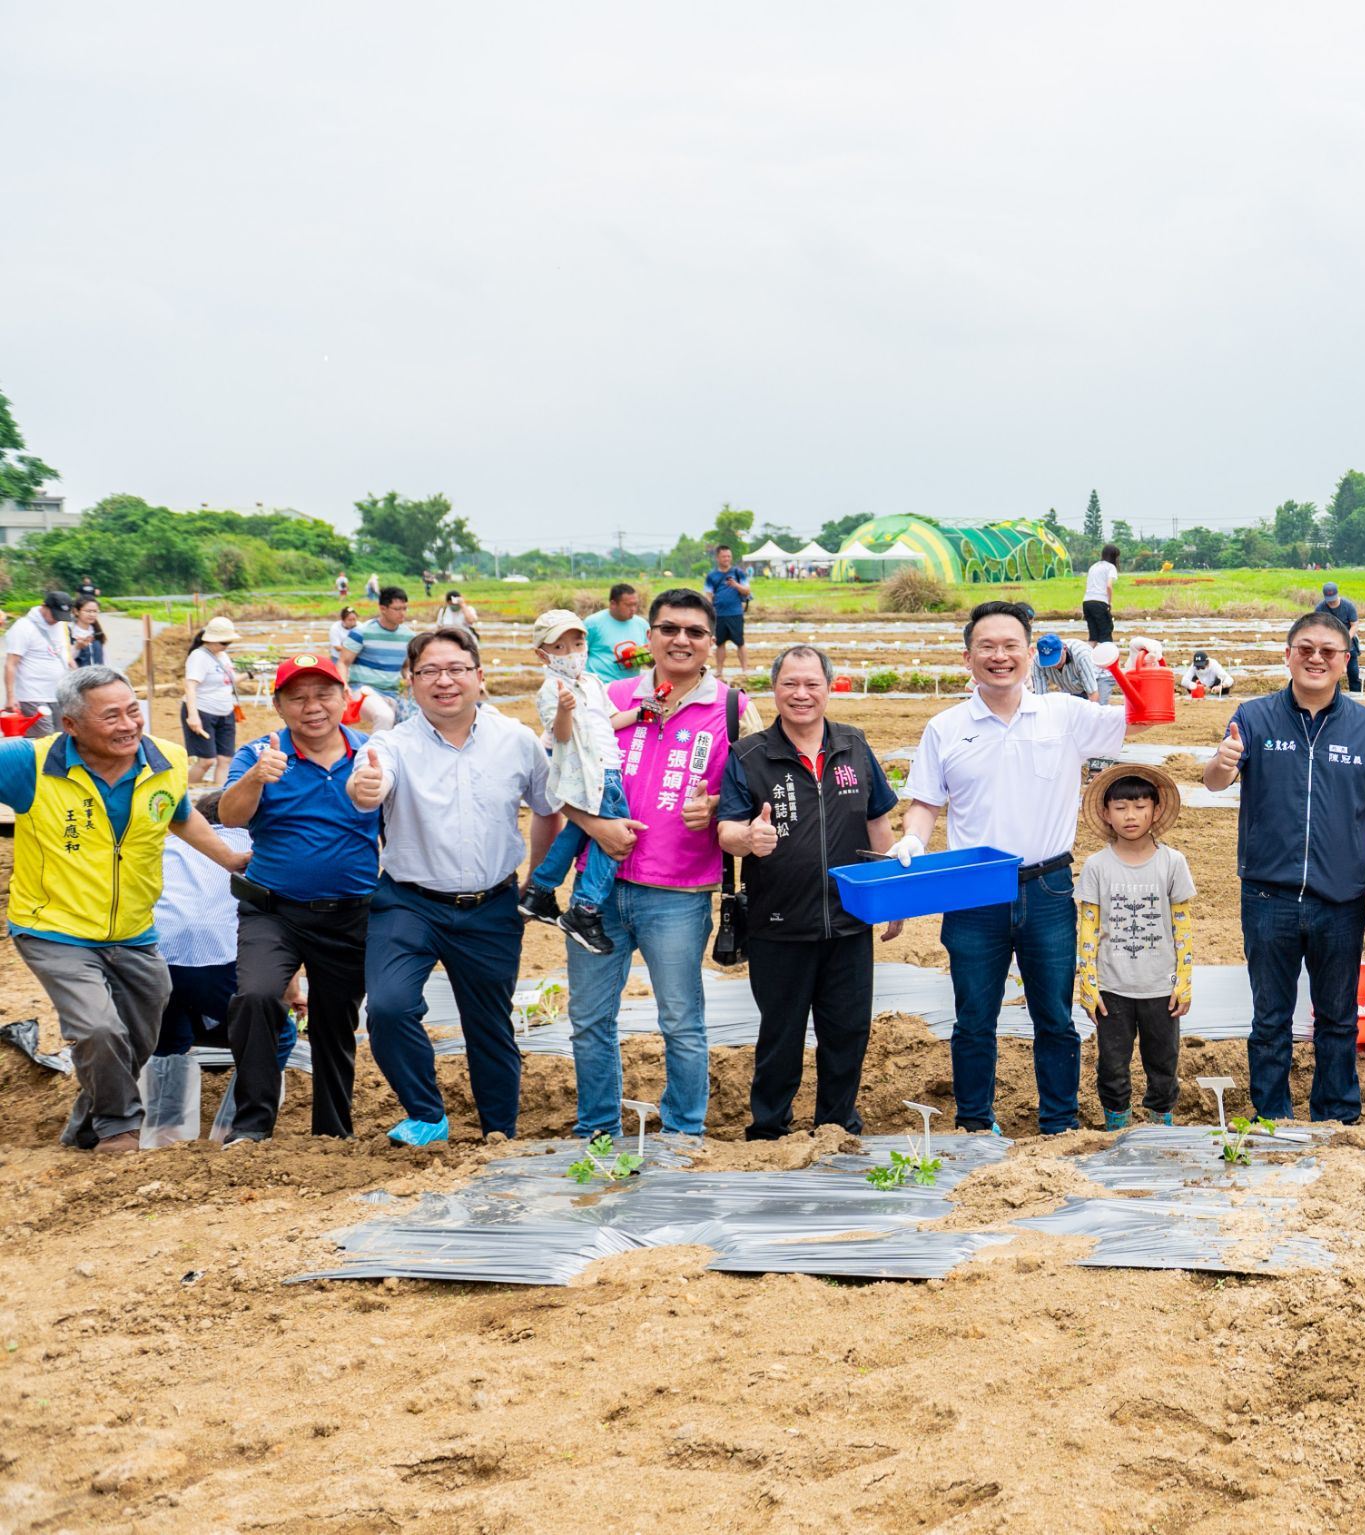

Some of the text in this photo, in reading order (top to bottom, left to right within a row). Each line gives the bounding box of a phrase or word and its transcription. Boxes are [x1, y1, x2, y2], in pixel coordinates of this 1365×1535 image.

[625, 726, 648, 777] 服務團隊
[692, 734, 710, 770] 桃園區
[656, 749, 688, 811] 張碩芳
[63, 809, 80, 853] 王應和
[83, 797, 95, 830] 理事長
[772, 784, 790, 838] 余誌松
